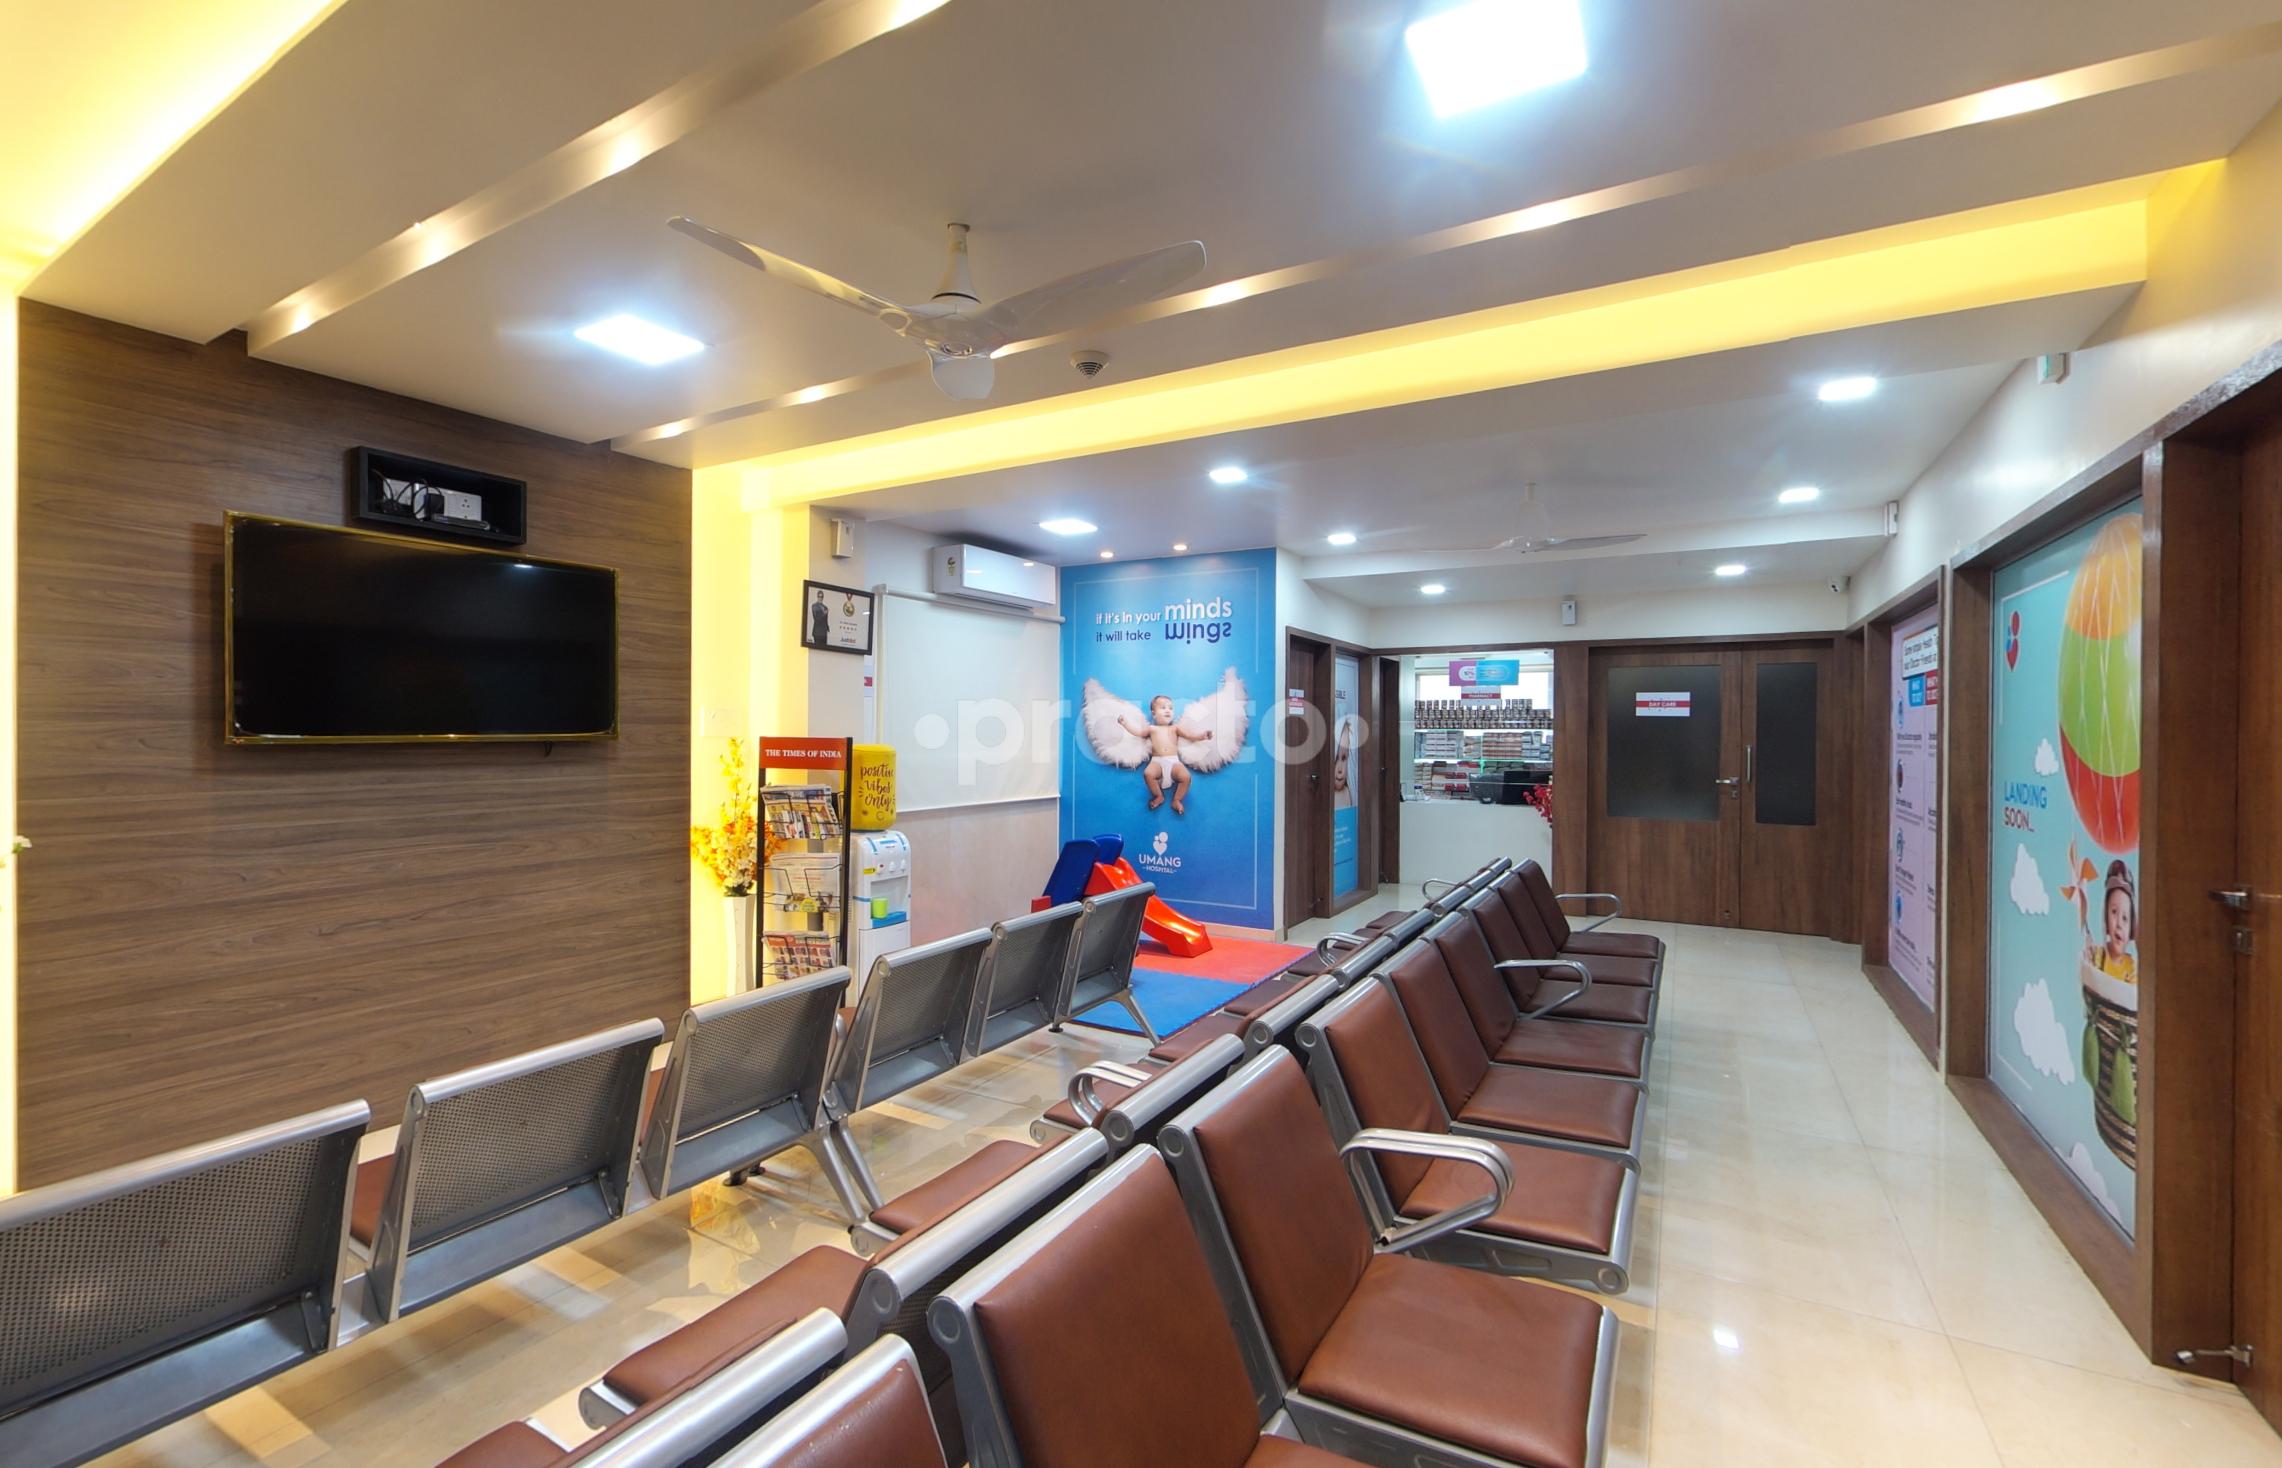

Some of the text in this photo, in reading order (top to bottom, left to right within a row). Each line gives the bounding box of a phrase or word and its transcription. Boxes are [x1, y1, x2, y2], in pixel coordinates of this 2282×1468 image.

[1096, 596, 1232, 625] if it's in your minds
[1096, 632, 1103, 642] it
[1106, 630, 1123, 642] will
[1126, 629, 1152, 641] take
[765, 748, 842, 758] THE TIMES OF INDIA
[2004, 781, 2048, 809] LANDING
[1138, 853, 1181, 868] UMANG
[1146, 865, 1174, 874] HOSPITAL
